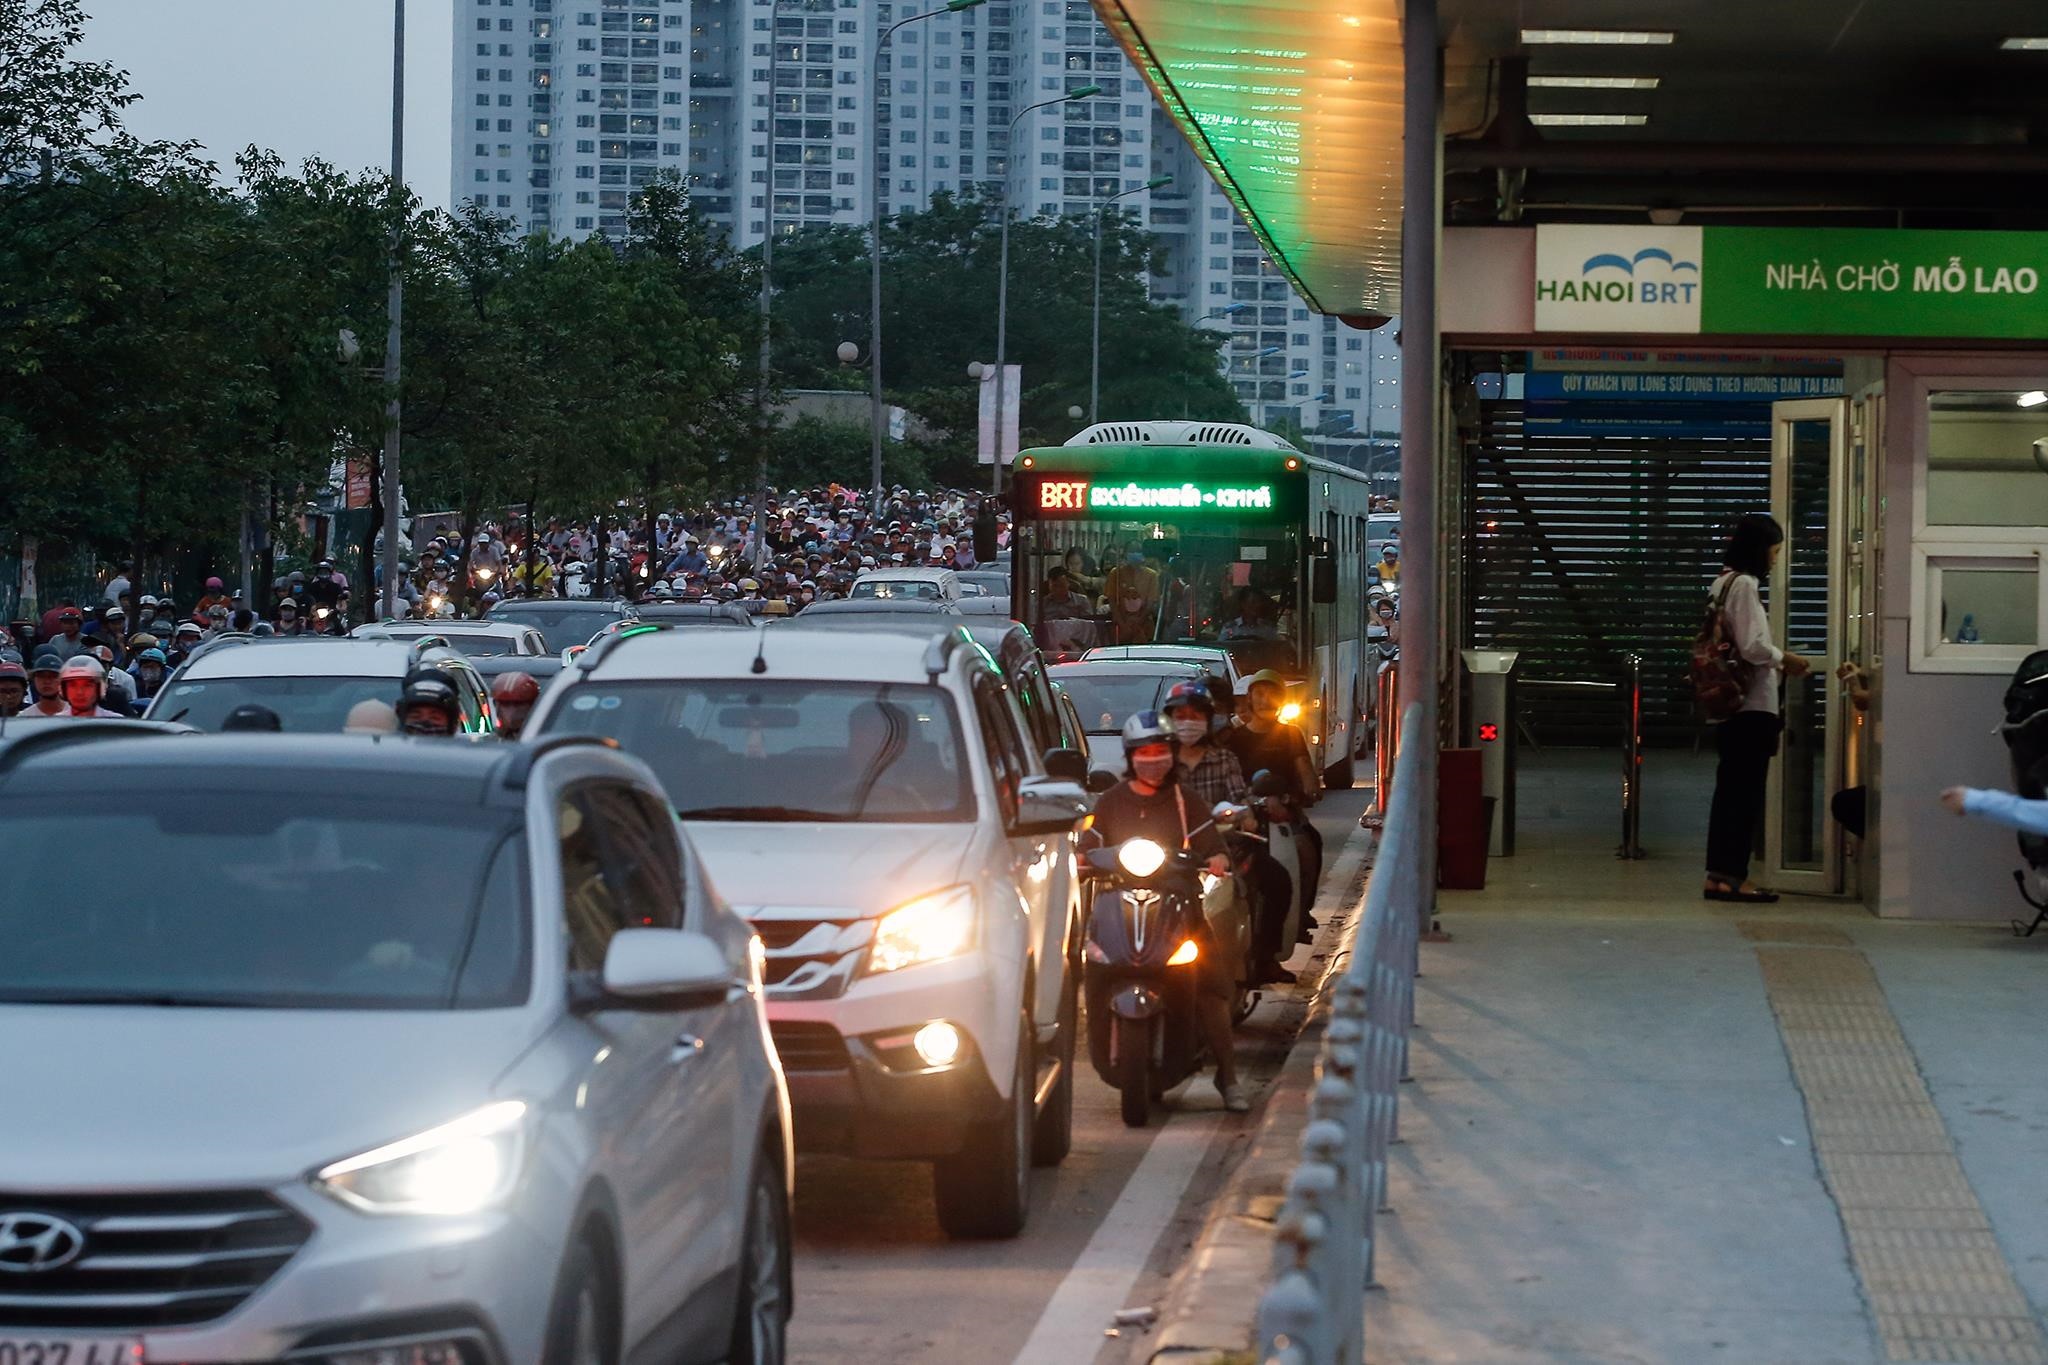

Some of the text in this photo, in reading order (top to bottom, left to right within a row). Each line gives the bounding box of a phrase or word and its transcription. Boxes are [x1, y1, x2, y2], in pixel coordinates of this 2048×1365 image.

[1766, 256, 2039, 294] NHÀ CHỜ MỖ LAO
[1537, 280, 1697, 304] HANOI BRT
[1620, 375, 1638, 392] VUI
[1715, 376, 1741, 393] THEO
[1041, 482, 1087, 508] BRT
